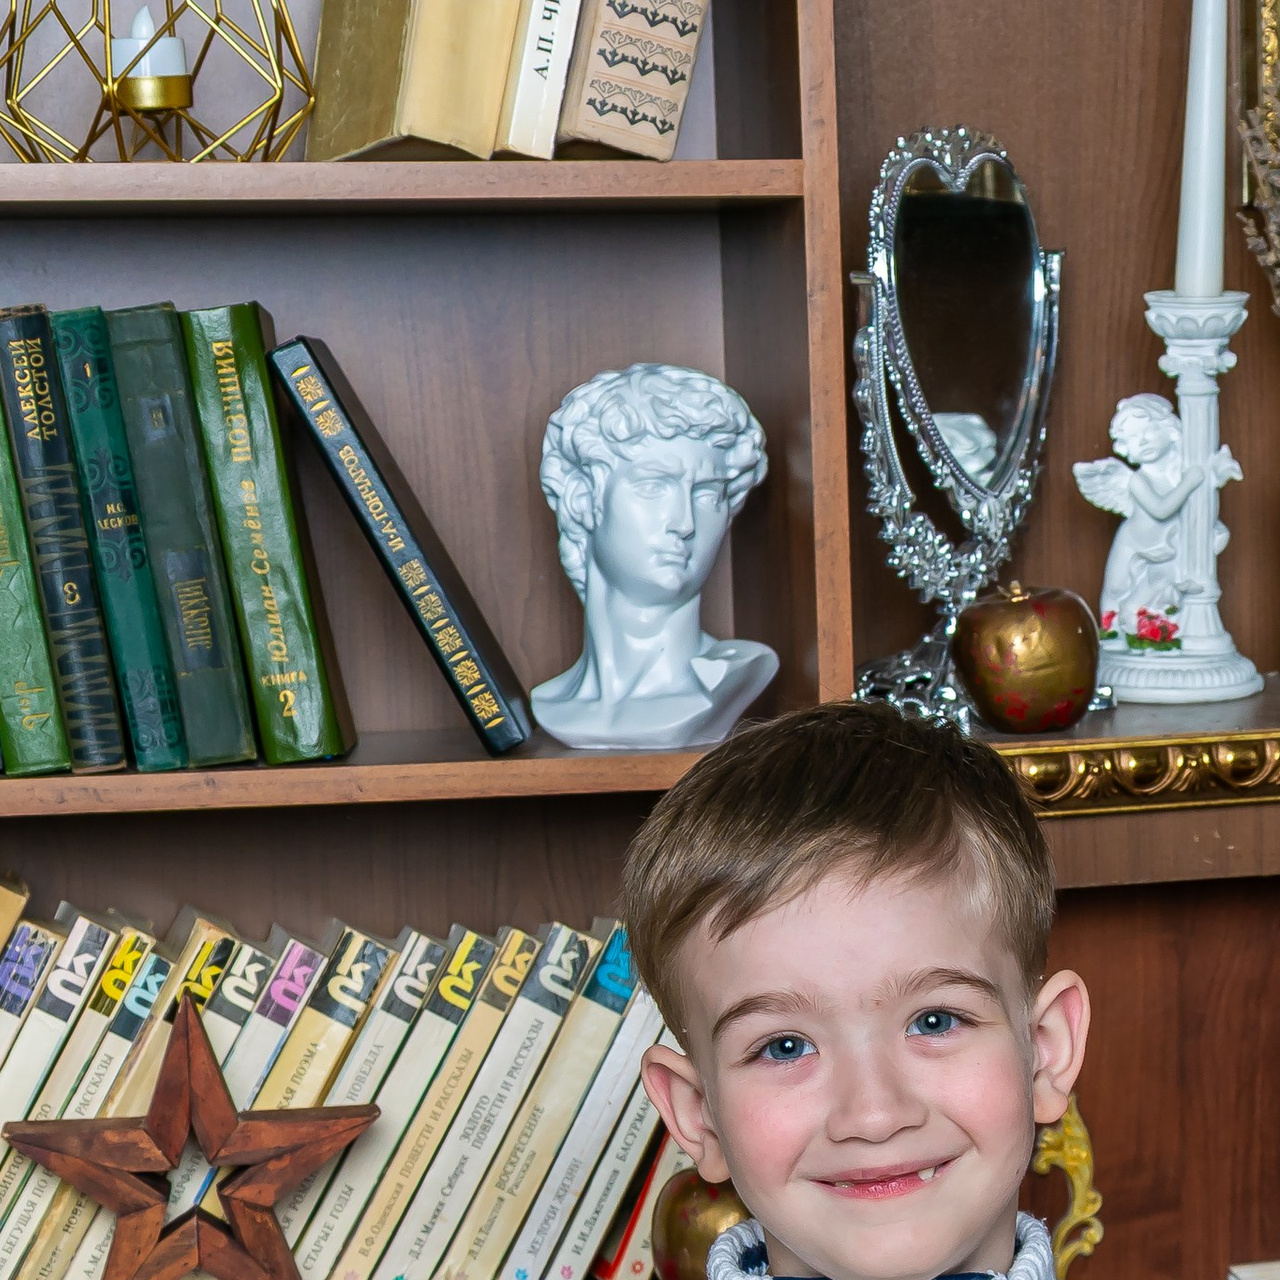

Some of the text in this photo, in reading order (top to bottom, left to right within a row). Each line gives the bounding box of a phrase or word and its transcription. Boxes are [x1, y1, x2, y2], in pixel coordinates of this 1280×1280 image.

[8, 339, 41, 441] АЛЕКСЕЙ
[24, 337, 58, 441] ТОЛСТОЙ
[240, 480, 271, 576] Семёнов
[63, 581, 81, 606] 3
[262, 669, 308, 687] КНИГА
[278, 689, 297, 717] 2
[291, 1041, 320, 1087] ПОЭМА
[345, 1042, 385, 1102] НОВЕЛЛА
[435, 1048, 474, 1119] РАССКАЗЫ
[471, 1018, 545, 1150] ПОВЕСТИ И РАССКАЗЫ
[431, 1109, 442, 1122] И
[459, 1094, 490, 1143] ЗОЛОТО
[495, 1105, 545, 1191] ВОСКРЕСЕНИЕ
[3, 1201, 37, 1256] БЕГУЩАЯ
[75, 1054, 114, 1116] РАССКАЗЫ
[399, 1123, 435, 1179] ПОВЕСТИ
[303, 1224, 334, 1271] СТАРЫЕ
[328, 1184, 355, 1220] ГОДЫ
